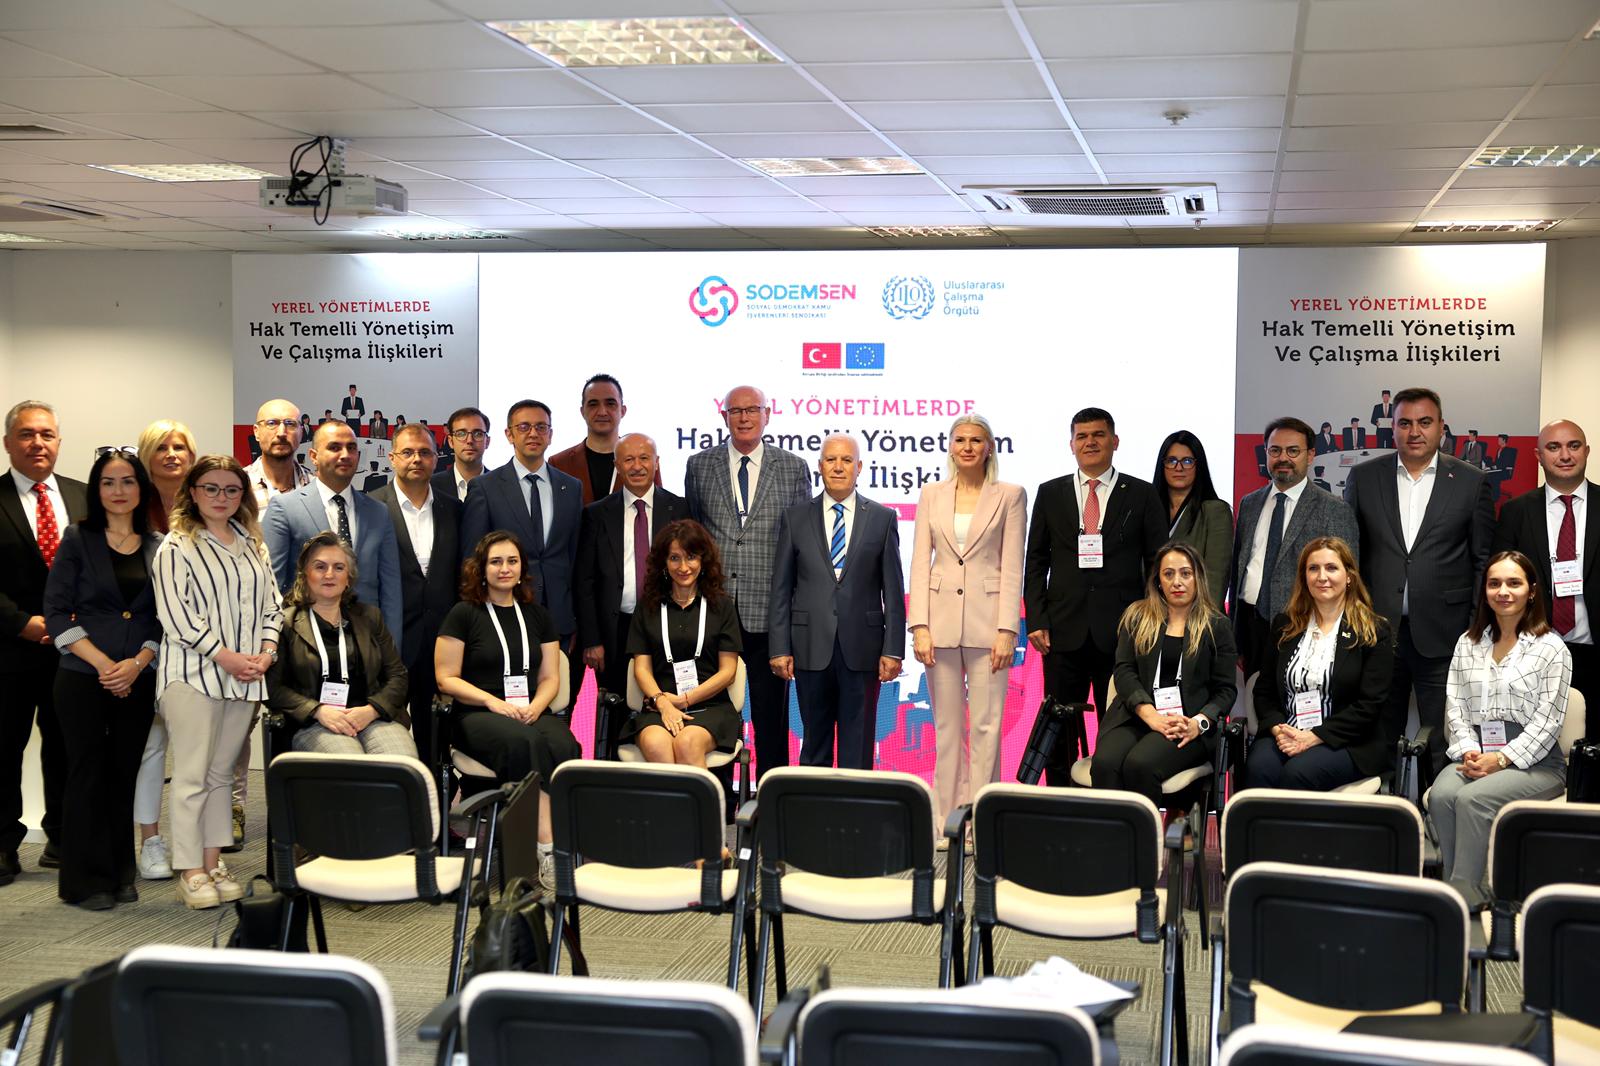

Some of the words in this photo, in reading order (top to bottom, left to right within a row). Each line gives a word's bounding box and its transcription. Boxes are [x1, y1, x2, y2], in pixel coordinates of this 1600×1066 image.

[746, 284, 856, 300] SODEMSEN
[943, 280, 1005, 290] Uluslararası
[898, 284, 921, 306] ILO
[943, 291, 984, 304] Çalışma
[1290, 299, 1343, 312] YEREL
[1349, 296, 1487, 312] YÖNETİMLERDE
[272, 302, 315, 314] YEREL
[319, 299, 431, 313] YÖNETİMLERDE
[943, 304, 980, 317] Örgütü
[250, 322, 285, 337] Hak
[290, 321, 358, 337] Temelli
[362, 321, 455, 339] Yönetişim
[1262, 321, 1304, 337] Hak
[1311, 320, 1394, 337] Temelli
[1400, 320, 1516, 340] Yönetişim
[261, 345, 283, 360] Ve
[289, 345, 362, 363] Çalışma
[368, 341, 443, 362] İlişkileri
[1275, 346, 1302, 362] Ve
[1309, 345, 1399, 366] Çalışma
[1406, 342, 1501, 366] İlişkileri
[791, 395, 977, 417] YÖNETİMLERDE
[861, 430, 1014, 454] Yönetm
